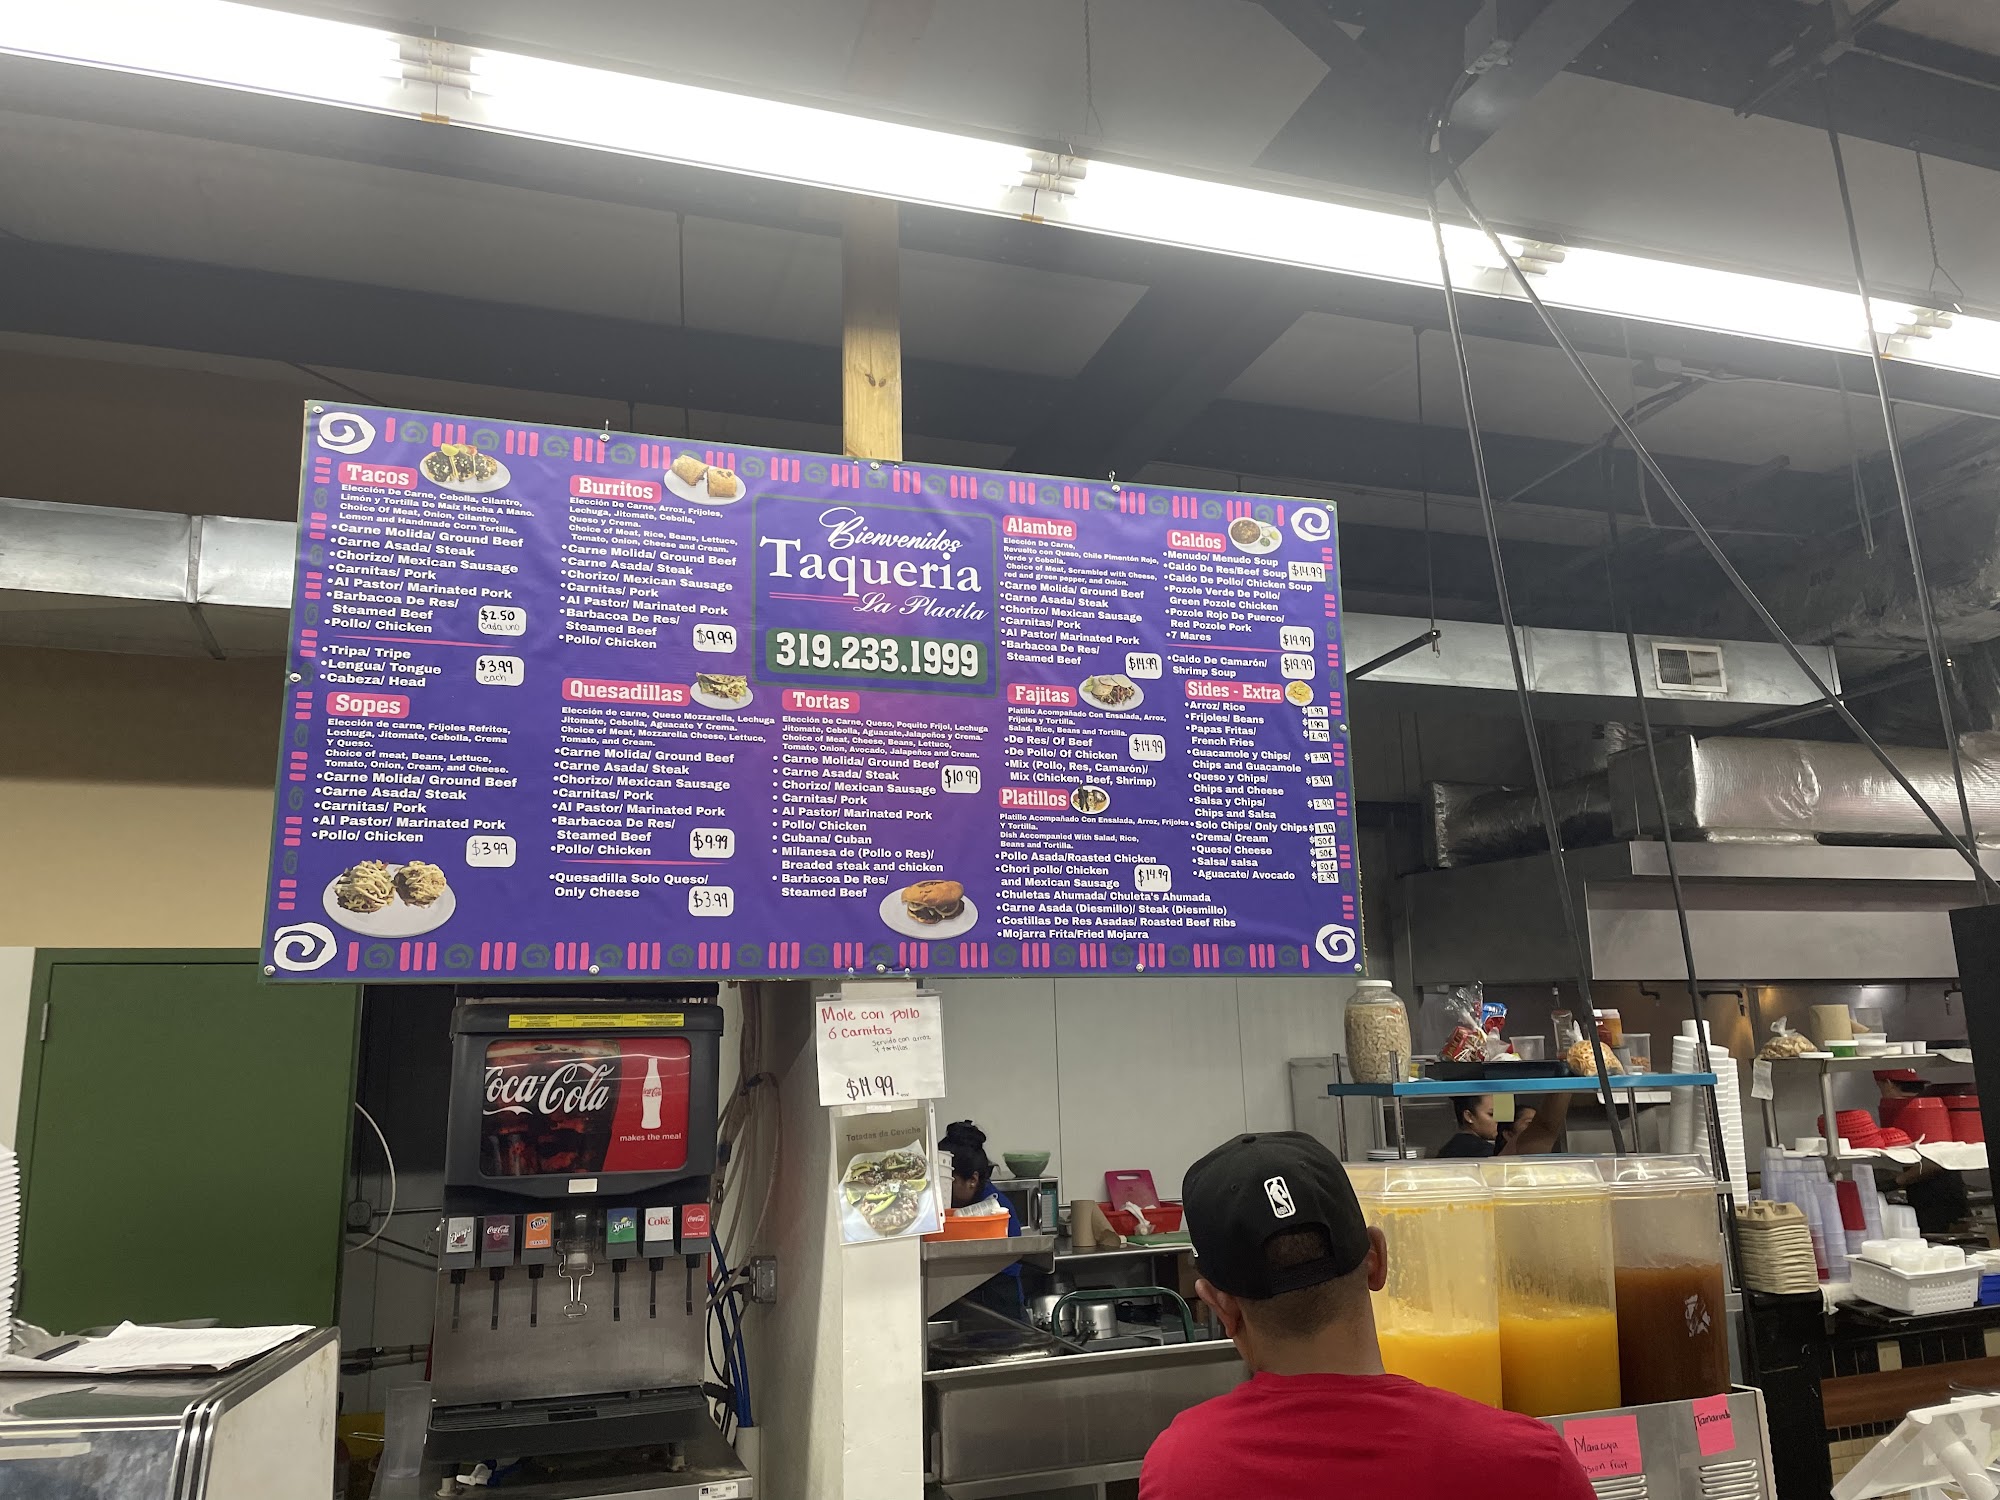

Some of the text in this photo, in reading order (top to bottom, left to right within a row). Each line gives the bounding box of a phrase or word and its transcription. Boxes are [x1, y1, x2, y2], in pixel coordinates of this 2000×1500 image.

[347, 463, 409, 485] Tacos
[341, 483, 385, 494] Elección
[403, 489, 436, 500] Carne,
[439, 493, 478, 504] Cebolla,
[481, 496, 522, 507] Cilantro,
[579, 477, 652, 499] Burritos
[338, 523, 523, 547] Carne Molida/ Ground Beef
[568, 524, 600, 533] Choice
[615, 528, 640, 537] Meat,
[643, 530, 666, 539] Rice,
[668, 532, 699, 542] Beans,
[701, 535, 737, 545] Lettuce,
[818, 506, 963, 553] Bienvenidos
[1007, 517, 1072, 537] Alambre
[1171, 531, 1221, 549] Caldos
[568, 544, 736, 565] Carne Molida/ Ground Beef
[1167, 550, 1278, 567] Menudo/ Menudo Soup
[759, 535, 982, 597] Taqueria
[333, 576, 512, 598] Al Pastor/ Marinated Pork
[567, 569, 732, 592] Chorizo/ Mexican Sausage
[1169, 584, 1280, 600] Pozole Verde De Pollo/
[853, 592, 989, 621] La Placita
[1169, 596, 1278, 610] Green Pozole Chicken
[481, 608, 515, 622] $2.50
[1005, 616, 1081, 629] Carnitas/ Pork
[697, 628, 733, 645] $9.99
[1170, 630, 1211, 641] 7 Mares
[327, 644, 411, 660] Tripa/ Tripe
[776, 631, 978, 676] 319.233.1999
[1006, 639, 1099, 654] Barbacoa De Res/
[328, 658, 441, 675] Lengua/ Tongue
[478, 659, 513, 674] $3.99
[1172, 665, 1236, 678] Shrimp Soup
[326, 672, 425, 686] Cabeza/ Head
[570, 680, 682, 702] Quesadillas
[1015, 685, 1069, 705] Fajitas
[1188, 681, 1229, 697] Sides
[1242, 683, 1281, 700] Extra
[335, 694, 400, 716] Sopes
[792, 691, 849, 709] Tortas
[1189, 700, 1245, 711] Arroz/ Rice
[1190, 712, 1264, 723] Frijoles/ Beans
[561, 725, 594, 733] Choice
[609, 728, 635, 737] Meat,
[638, 729, 688, 738] Mozzarella
[690, 731, 726, 741] Cheese,
[729, 733, 765, 743] Lettuce,
[1008, 734, 1092, 746] De Res/ Of Beef
[1133, 737, 1163, 754] $14.99
[1192, 759, 1301, 772] Chips and Guacamole
[1002, 788, 1066, 806] Platillos
[321, 800, 426, 813] Carnitas/ Pork
[693, 831, 728, 851] $9.99
[781, 833, 871, 844] Cubana/ Cuban
[781, 846, 934, 860] Milanesa de (Pollo o Res)/
[781, 860, 943, 871] Breaded steak and chicken
[555, 872, 708, 885] Quesadilla Solo Queso/
[1138, 869, 1168, 887] $14.99
[554, 886, 639, 899] Only Cheese
[693, 890, 728, 908] $3.99
[1001, 889, 1211, 901] Chuletas Ahumada/ Chuleta's Ahumada
[1002, 928, 1149, 940] Mojarra Frita/Fried Mojarra
[821, 1006, 920, 1024] Mole con pollo
[841, 1025, 893, 1039] Carnitas
[620, 1134, 646, 1142] makes
[662, 1132, 682, 1140] meal
[890, 1127, 921, 1136] Ceviche
[647, 1216, 671, 1226] Coke
